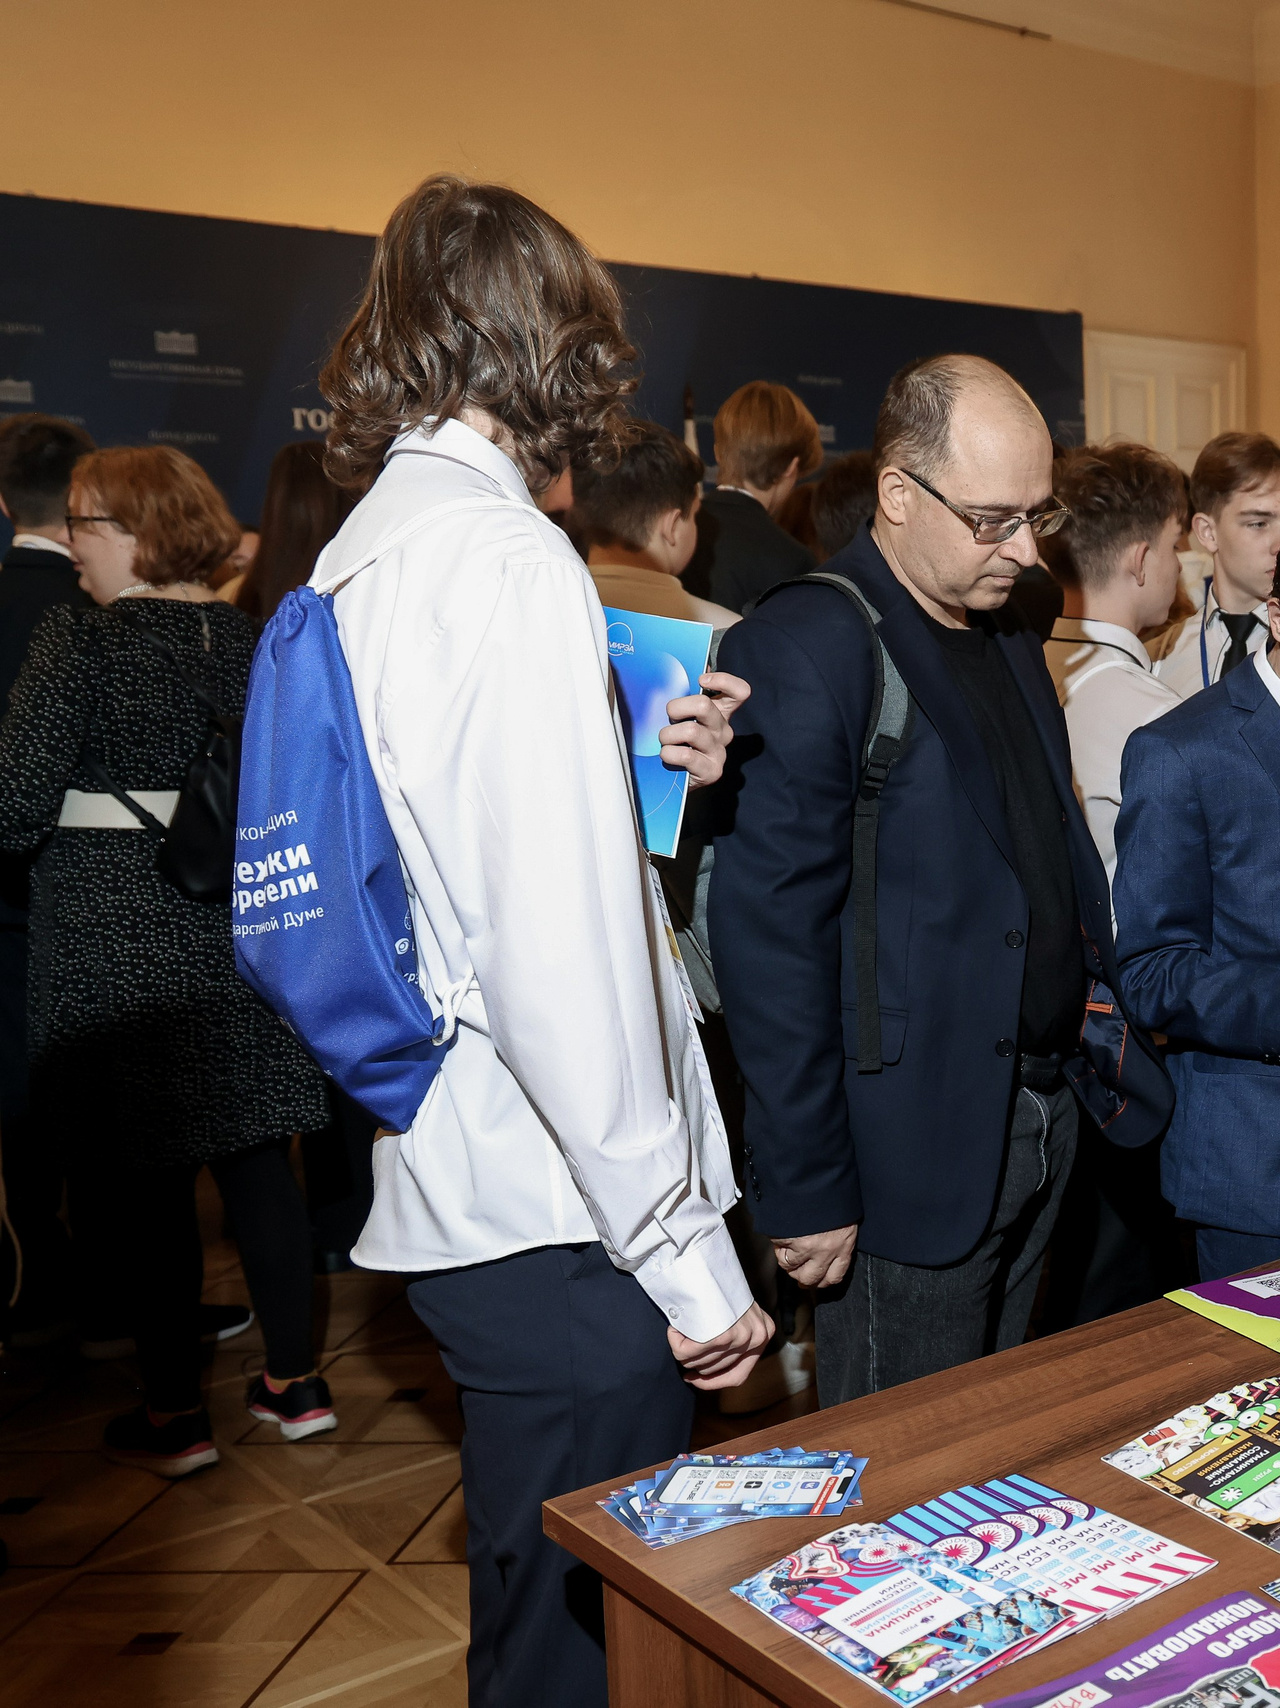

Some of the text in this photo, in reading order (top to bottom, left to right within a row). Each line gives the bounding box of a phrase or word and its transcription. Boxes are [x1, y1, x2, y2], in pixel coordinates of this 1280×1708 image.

[283, 906, 325, 930] Думе
[1171, 1446, 1220, 1477] ТВОРЧЕСТВО
[1196, 1441, 1254, 1477] НАПРАВЛЕНИЯ
[1205, 1445, 1261, 1481] СОЦИАЛЬНЫЕ
[1209, 1448, 1271, 1489] ГУМАНИТАРНО-
[842, 1581, 918, 1624] ЕСТЕСТВЕННЫЕ
[879, 1576, 911, 1596] НАУКИ
[857, 1590, 935, 1634] ВЕТЕРИНАРИЯ
[865, 1595, 943, 1638] МЕДИЦИНА
[1104, 1597, 1269, 1682] ПОЖАЛОВАТЬ
